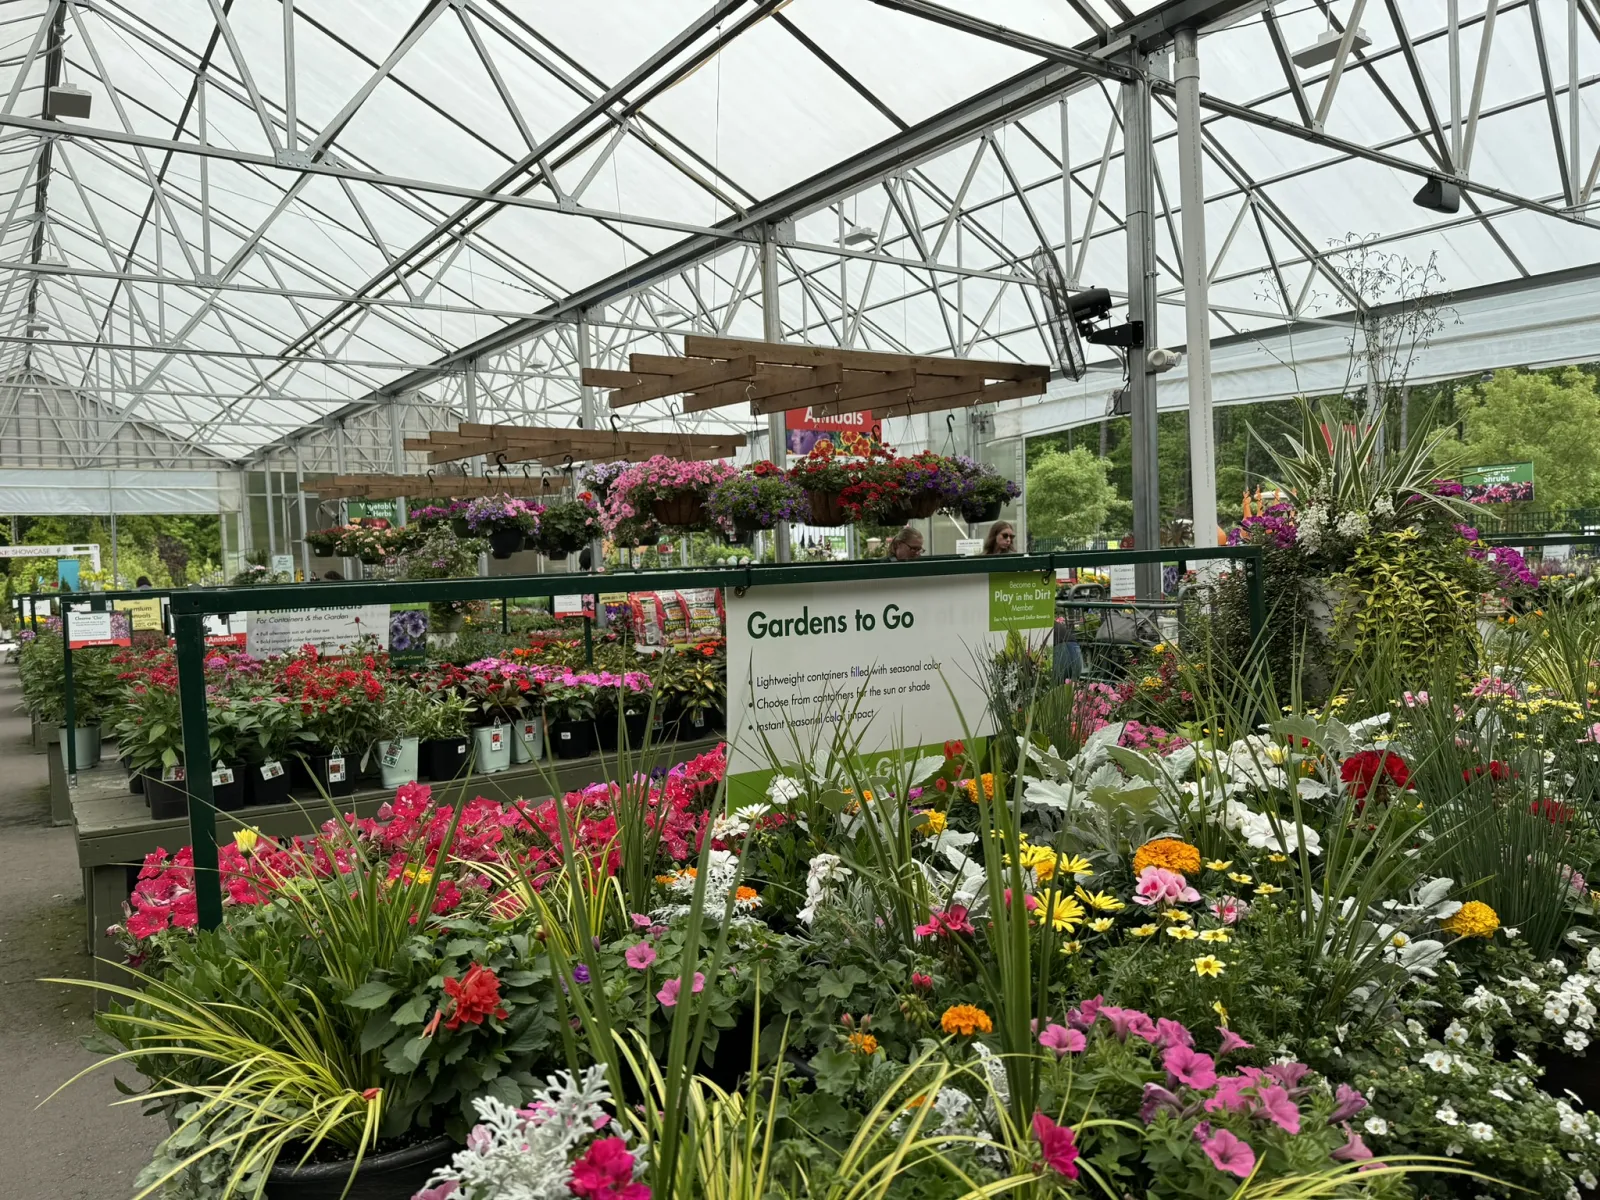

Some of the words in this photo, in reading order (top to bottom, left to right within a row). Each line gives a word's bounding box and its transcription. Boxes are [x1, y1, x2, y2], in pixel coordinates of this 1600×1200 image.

[1483, 474, 1510, 483] Shrubs
[1009, 581, 1031, 589] Become
[994, 590, 1014, 605] Play
[1015, 592, 1022, 601] in
[1023, 592, 1033, 601] the
[1034, 588, 1051, 600] Dirt
[1011, 602, 1034, 612] Member
[269, 615, 304, 624] Containers
[305, 614, 312, 622] &
[324, 612, 349, 621] Garden
[747, 605, 847, 639] Gardens
[855, 609, 876, 631] to
[883, 603, 914, 629] Go
[208, 634, 237, 643] Annuals
[756, 671, 805, 689] Lightweight
[807, 670, 848, 682] containers
[850, 665, 869, 677] filled
[872, 663, 887, 675] with
[889, 660, 921, 674] seasonal
[923, 659, 942, 671] color
[756, 697, 789, 709] Choose
[791, 693, 811, 705] from
[869, 685, 881, 697] the
[883, 687, 896, 695] sun
[898, 686, 907, 694] or
[908, 680, 931, 692] shade
[756, 721, 784, 732] Instant
[825, 711, 845, 723] colo
[848, 708, 874, 722] impact
